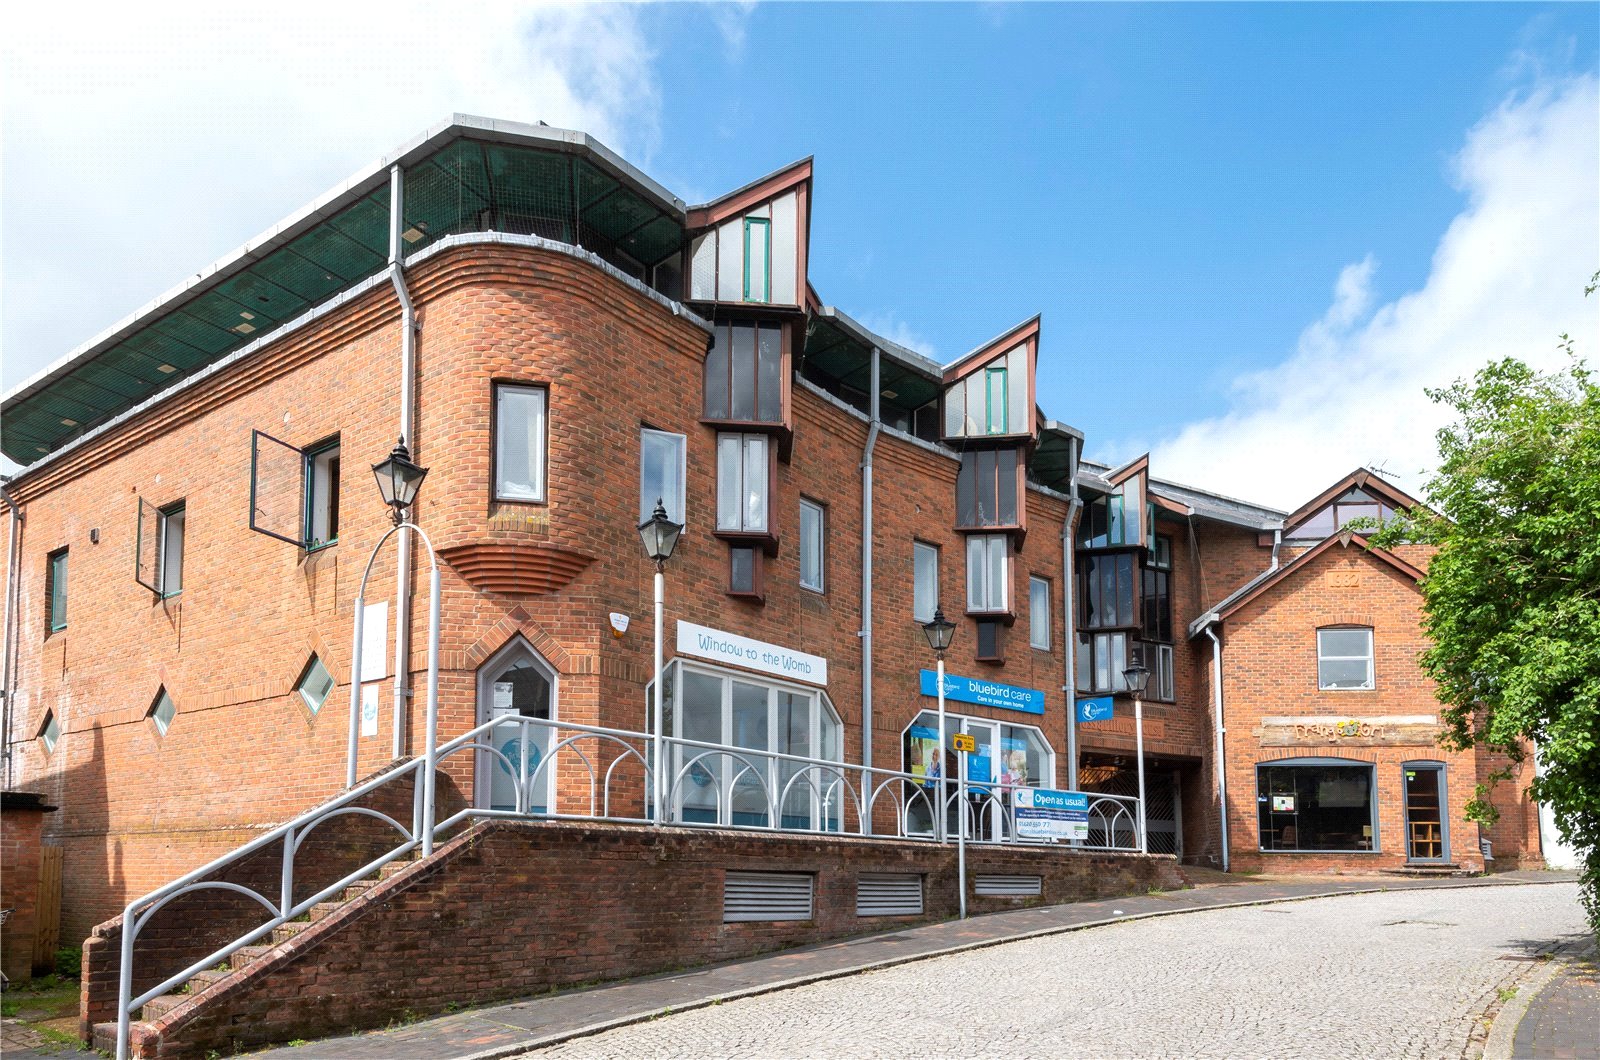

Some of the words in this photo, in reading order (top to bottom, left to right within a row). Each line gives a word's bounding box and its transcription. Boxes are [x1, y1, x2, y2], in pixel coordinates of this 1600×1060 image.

[698, 633, 743, 657] Window
[746, 648, 758, 660] to
[762, 652, 780, 666] the
[781, 654, 812, 674] Womb
[968, 680, 1010, 698] bluebird
[1010, 688, 1032, 702] care
[977, 695, 987, 703] Care
[993, 697, 1003, 705] your
[1012, 700, 1025, 709] home
[1294, 723, 1343, 743] Frango
[1034, 793, 1055, 806] Open
[1055, 797, 1063, 806] as
[1064, 797, 1086, 807] usual!
